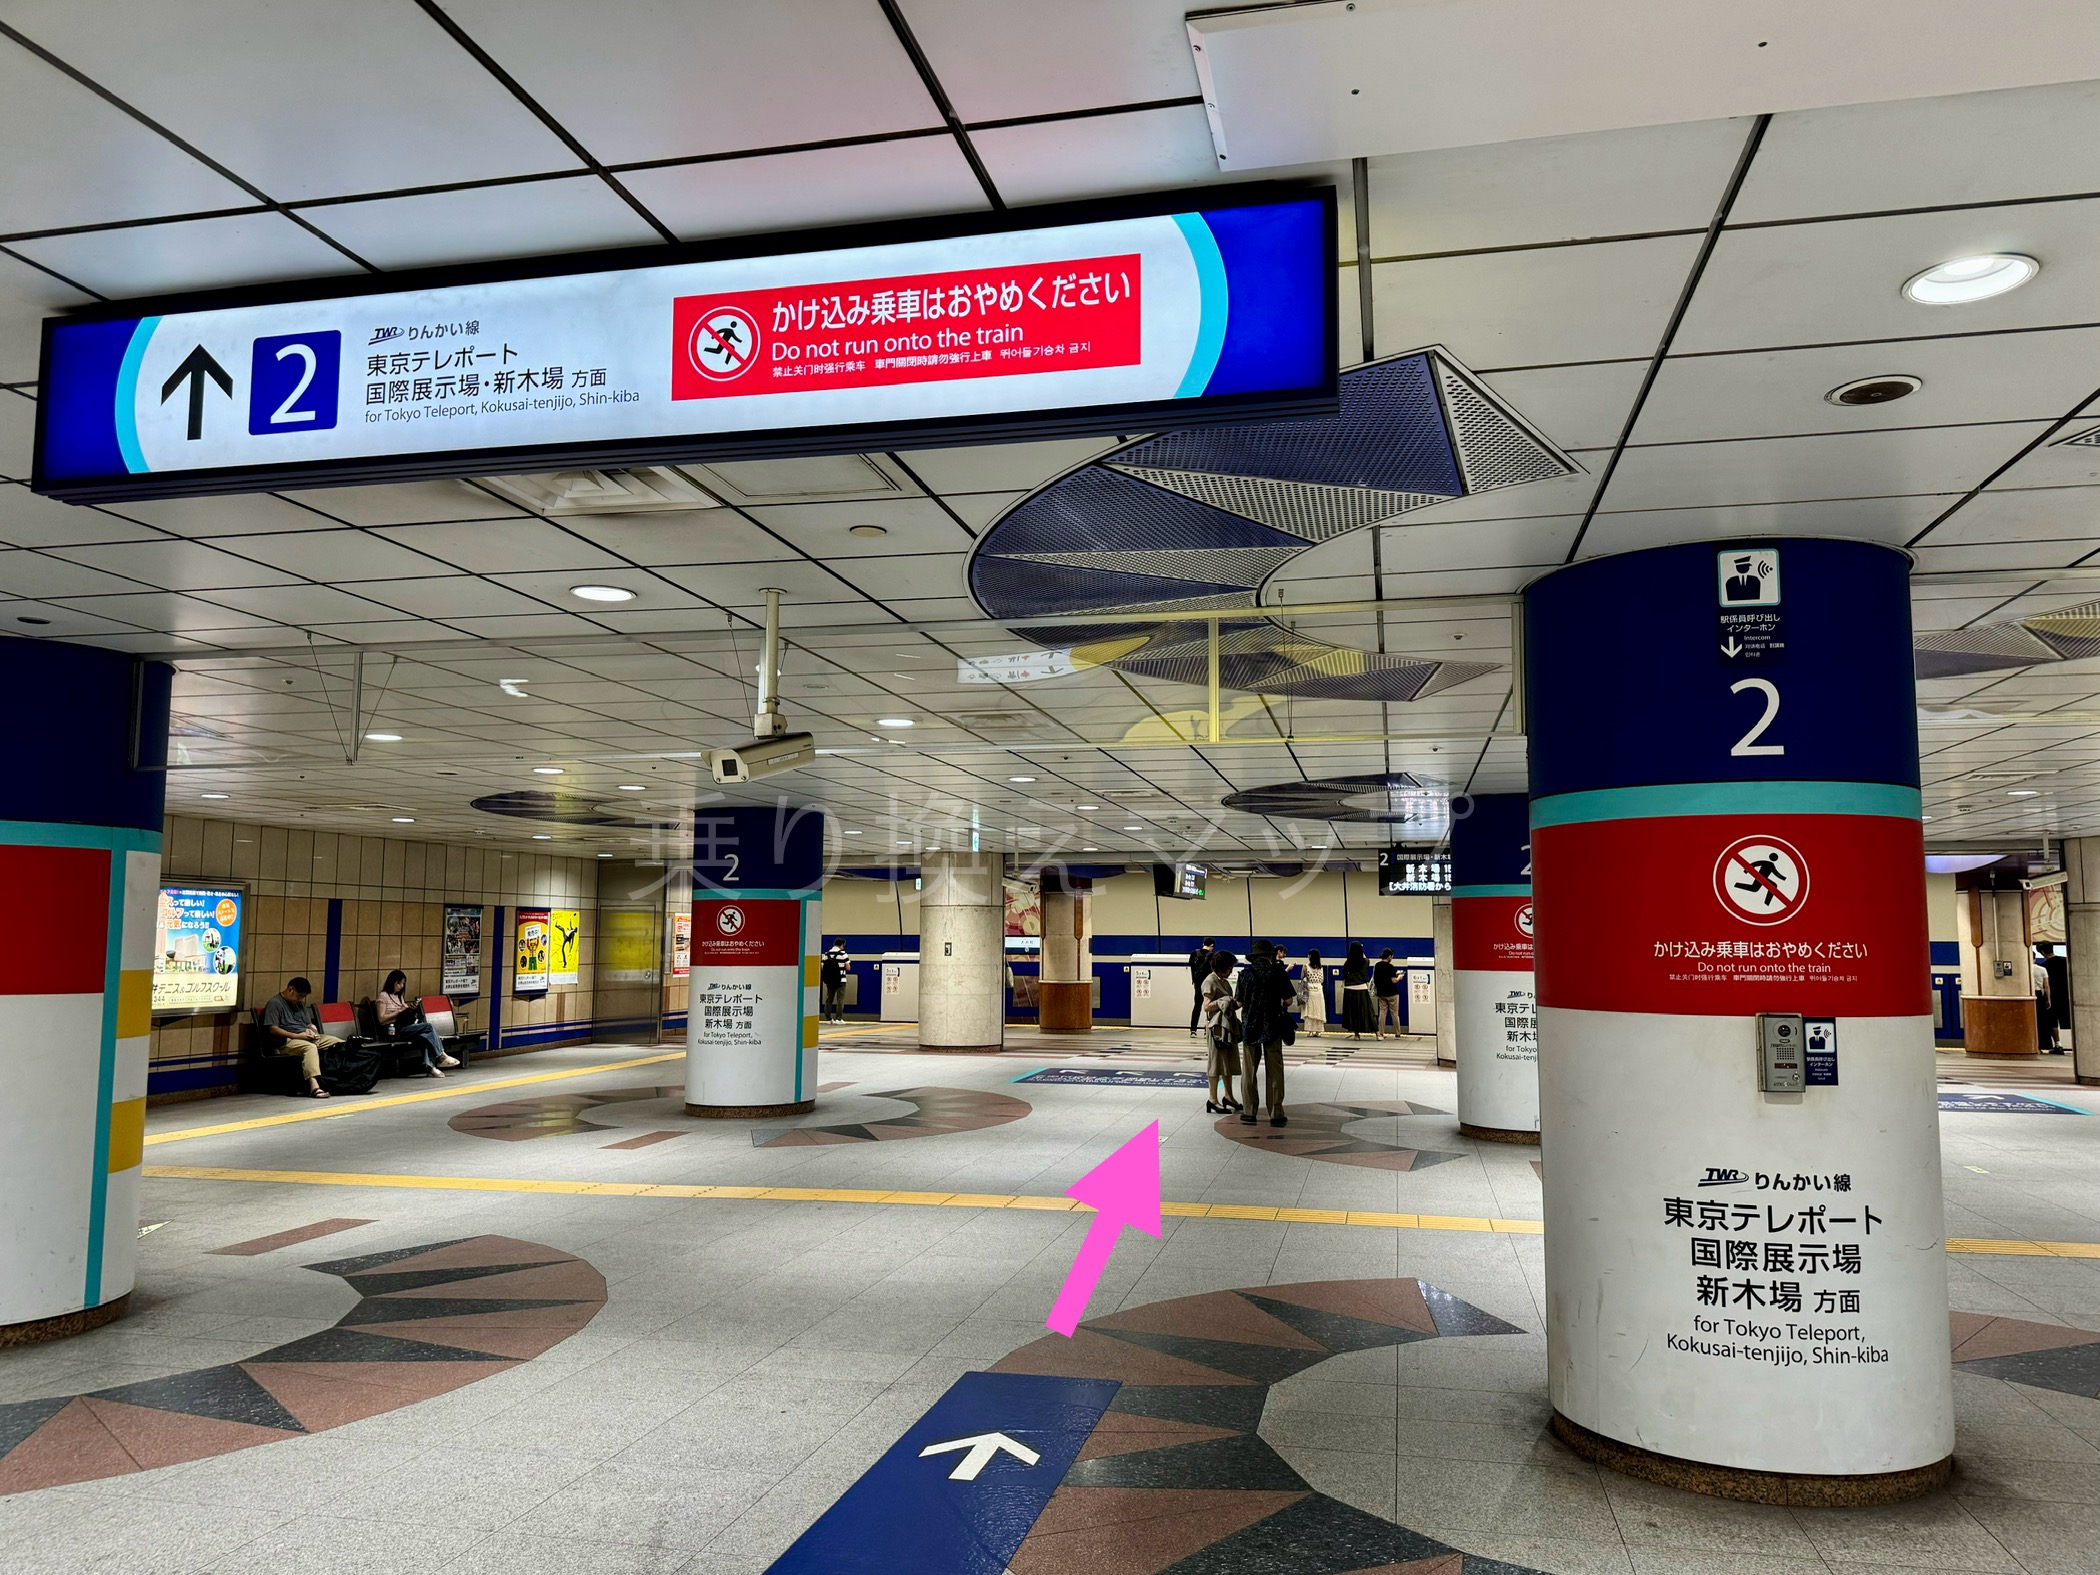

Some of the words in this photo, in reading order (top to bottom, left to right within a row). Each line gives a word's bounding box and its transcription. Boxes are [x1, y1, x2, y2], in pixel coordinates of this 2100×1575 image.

[771, 271, 1131, 334] かけ込み乗車はおやめください
[407, 320, 481, 341] りんかい線
[771, 341, 800, 362] Do
[805, 337, 840, 360] not
[845, 336, 878, 356] run
[883, 330, 931, 353] onto
[935, 326, 970, 350] the
[975, 323, 1025, 346] train
[366, 343, 519, 377] 東京テレポート
[1068, 341, 1091, 354] 금지
[269, 343, 318, 425] 2
[365, 366, 565, 406] 国際展示場・新木場
[571, 368, 607, 389] 方面
[365, 409, 382, 423] for
[385, 406, 421, 424] Tokyo
[424, 403, 478, 421] Teleport,
[481, 395, 576, 415] Kokusai-tenjijo,
[579, 389, 640, 407] Shin-kiba
[1720, 613, 1780, 624] 駅係員呼び出し
[1727, 623, 1776, 633] インターホン
[1729, 677, 1785, 757] 2
[722, 853, 740, 881] 2
[1379, 852, 1389, 866] 2
[1653, 940, 1869, 960] かけ込み乗車はおやめください
[1697, 962, 1714, 972] Do
[1716, 962, 1736, 972] not
[1738, 964, 1756, 972] run
[1759, 963, 1786, 972] onto
[1787, 962, 1806, 972] the
[1808, 962, 1831, 972] train
[699, 993, 763, 1004] 東京テレポート
[704, 1005, 754, 1017] 国際展示場
[704, 1018, 733, 1029] 新木場
[736, 1021, 752, 1029] 方面
[1701, 1167, 1744, 1184] TWR
[1754, 1172, 1852, 1193] りんかい線
[1663, 1197, 1883, 1235] 東京テレポート
[1690, 1236, 1862, 1275] 国際展示場
[1696, 1274, 1802, 1313] 新木場
[1813, 1289, 1861, 1314] 方面
[1693, 1315, 1720, 1334] for
[1723, 1318, 1782, 1342] Tokyo
[1785, 1323, 1866, 1345] Teleport,
[1666, 1333, 1809, 1367] Kokusai-tenjijo,
[1812, 1346, 1889, 1365] Shin-kiba
